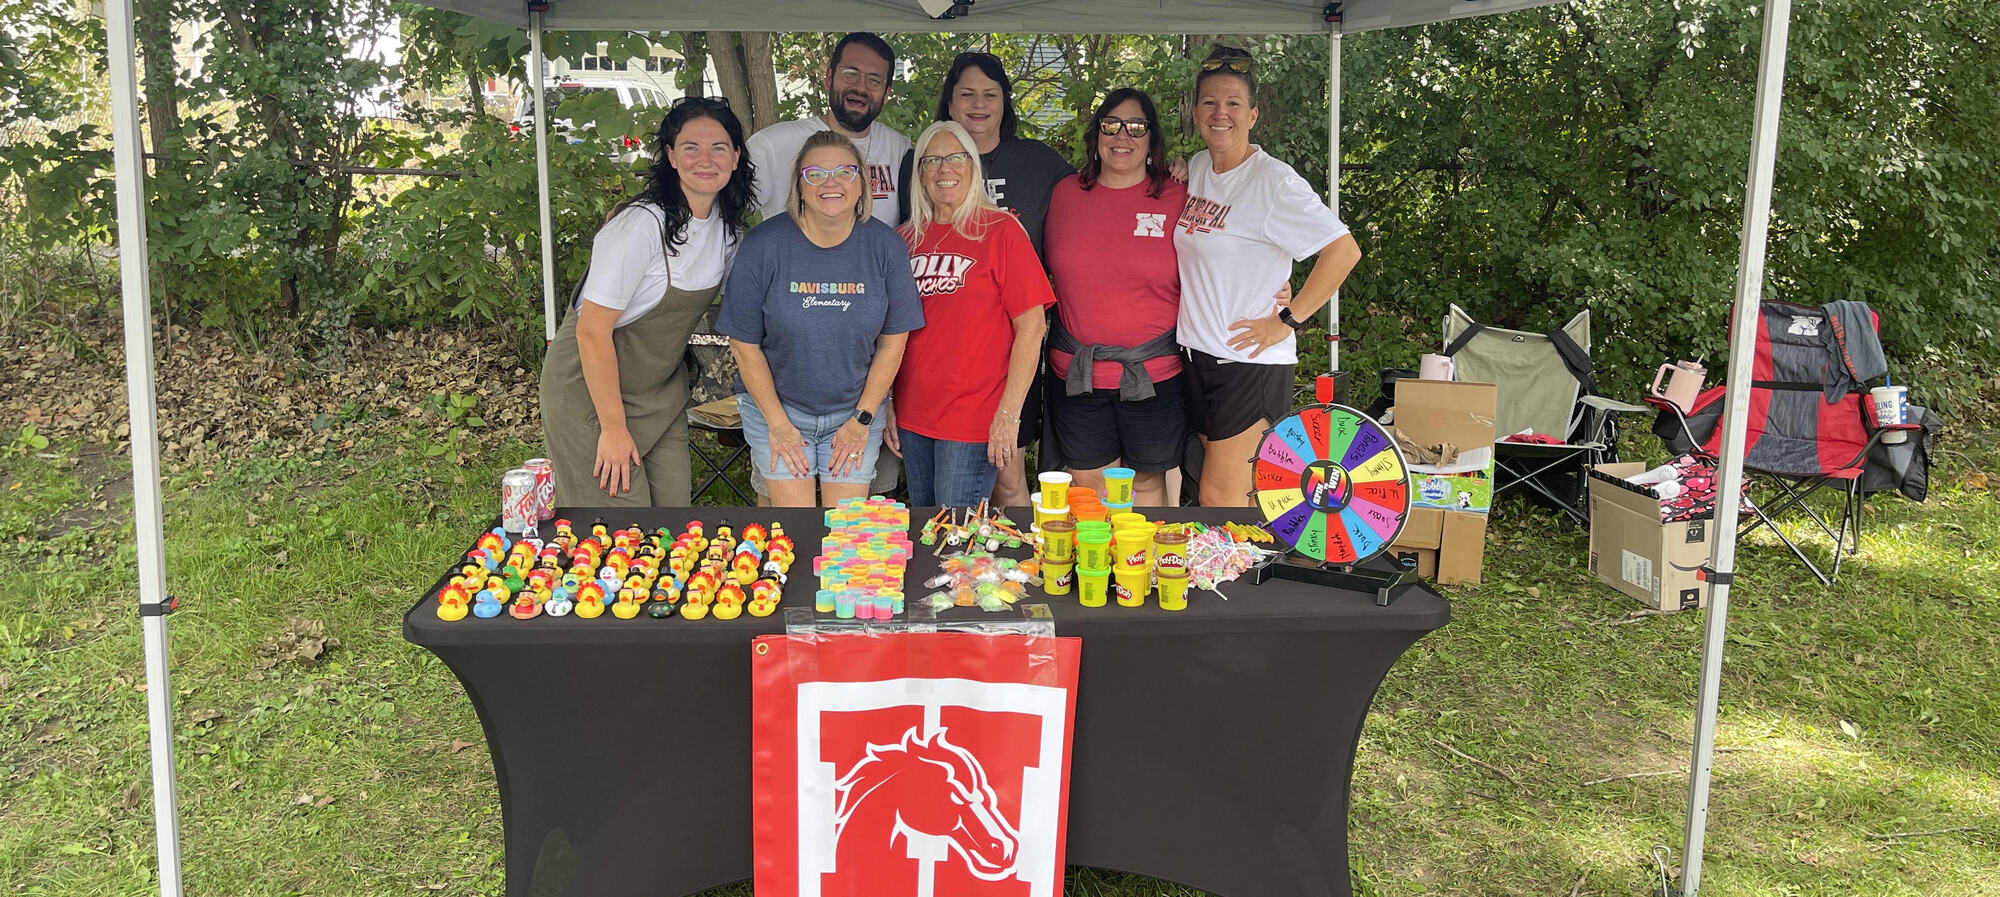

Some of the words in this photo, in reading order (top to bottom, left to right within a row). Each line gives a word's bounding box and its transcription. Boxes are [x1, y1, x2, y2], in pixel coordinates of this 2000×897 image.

[909, 254, 974, 286] OLLY
[789, 281, 865, 295] DAVISBURG
[915, 276, 959, 293] NCHOS
[802, 295, 852, 312] Elementary
[1336, 416, 1351, 437] Duck
[1350, 431, 1379, 461] Pencils
[1312, 482, 1325, 505] SPIN
[1328, 467, 1341, 489] WIN
[1352, 521, 1373, 551] Duck
